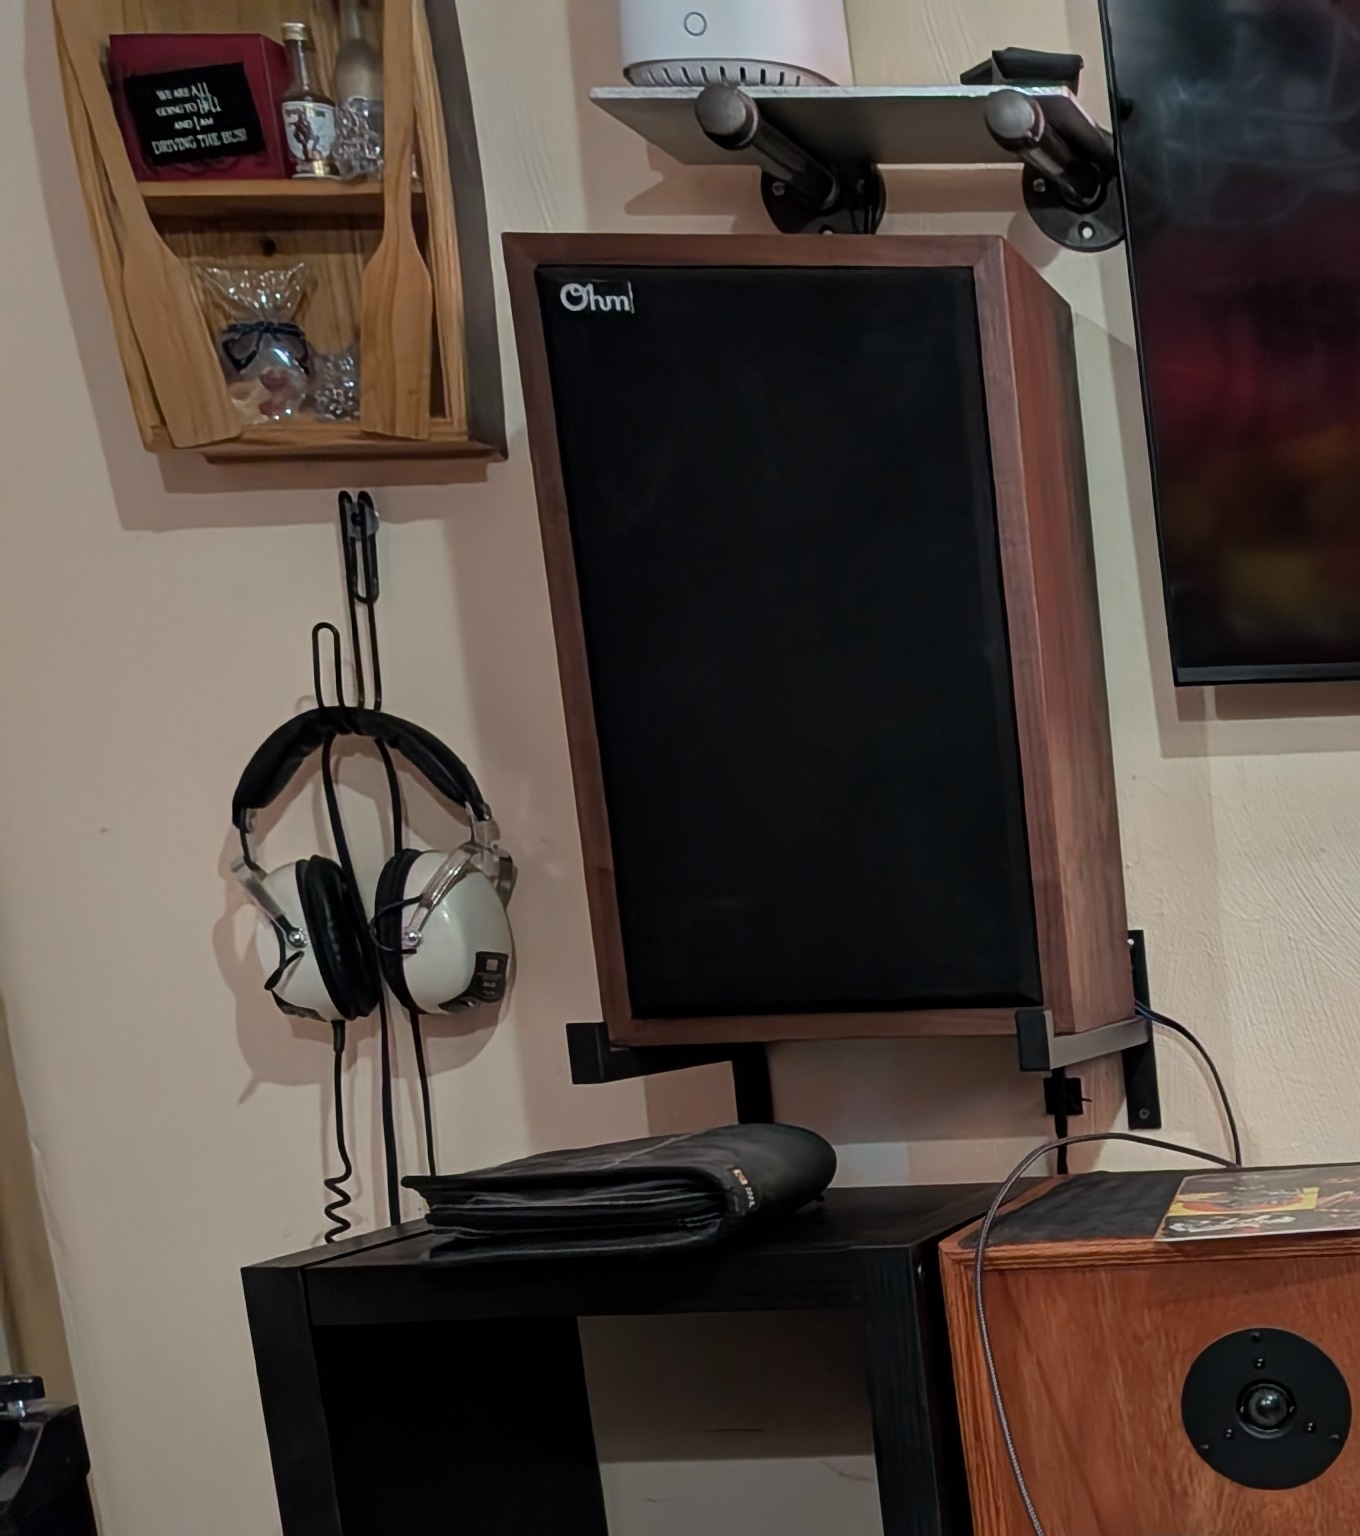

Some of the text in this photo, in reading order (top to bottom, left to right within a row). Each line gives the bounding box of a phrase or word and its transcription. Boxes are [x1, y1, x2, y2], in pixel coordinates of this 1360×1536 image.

[151, 134, 197, 155] DRIVING
[196, 131, 221, 148] THE
[560, 283, 630, 312] Ohm
